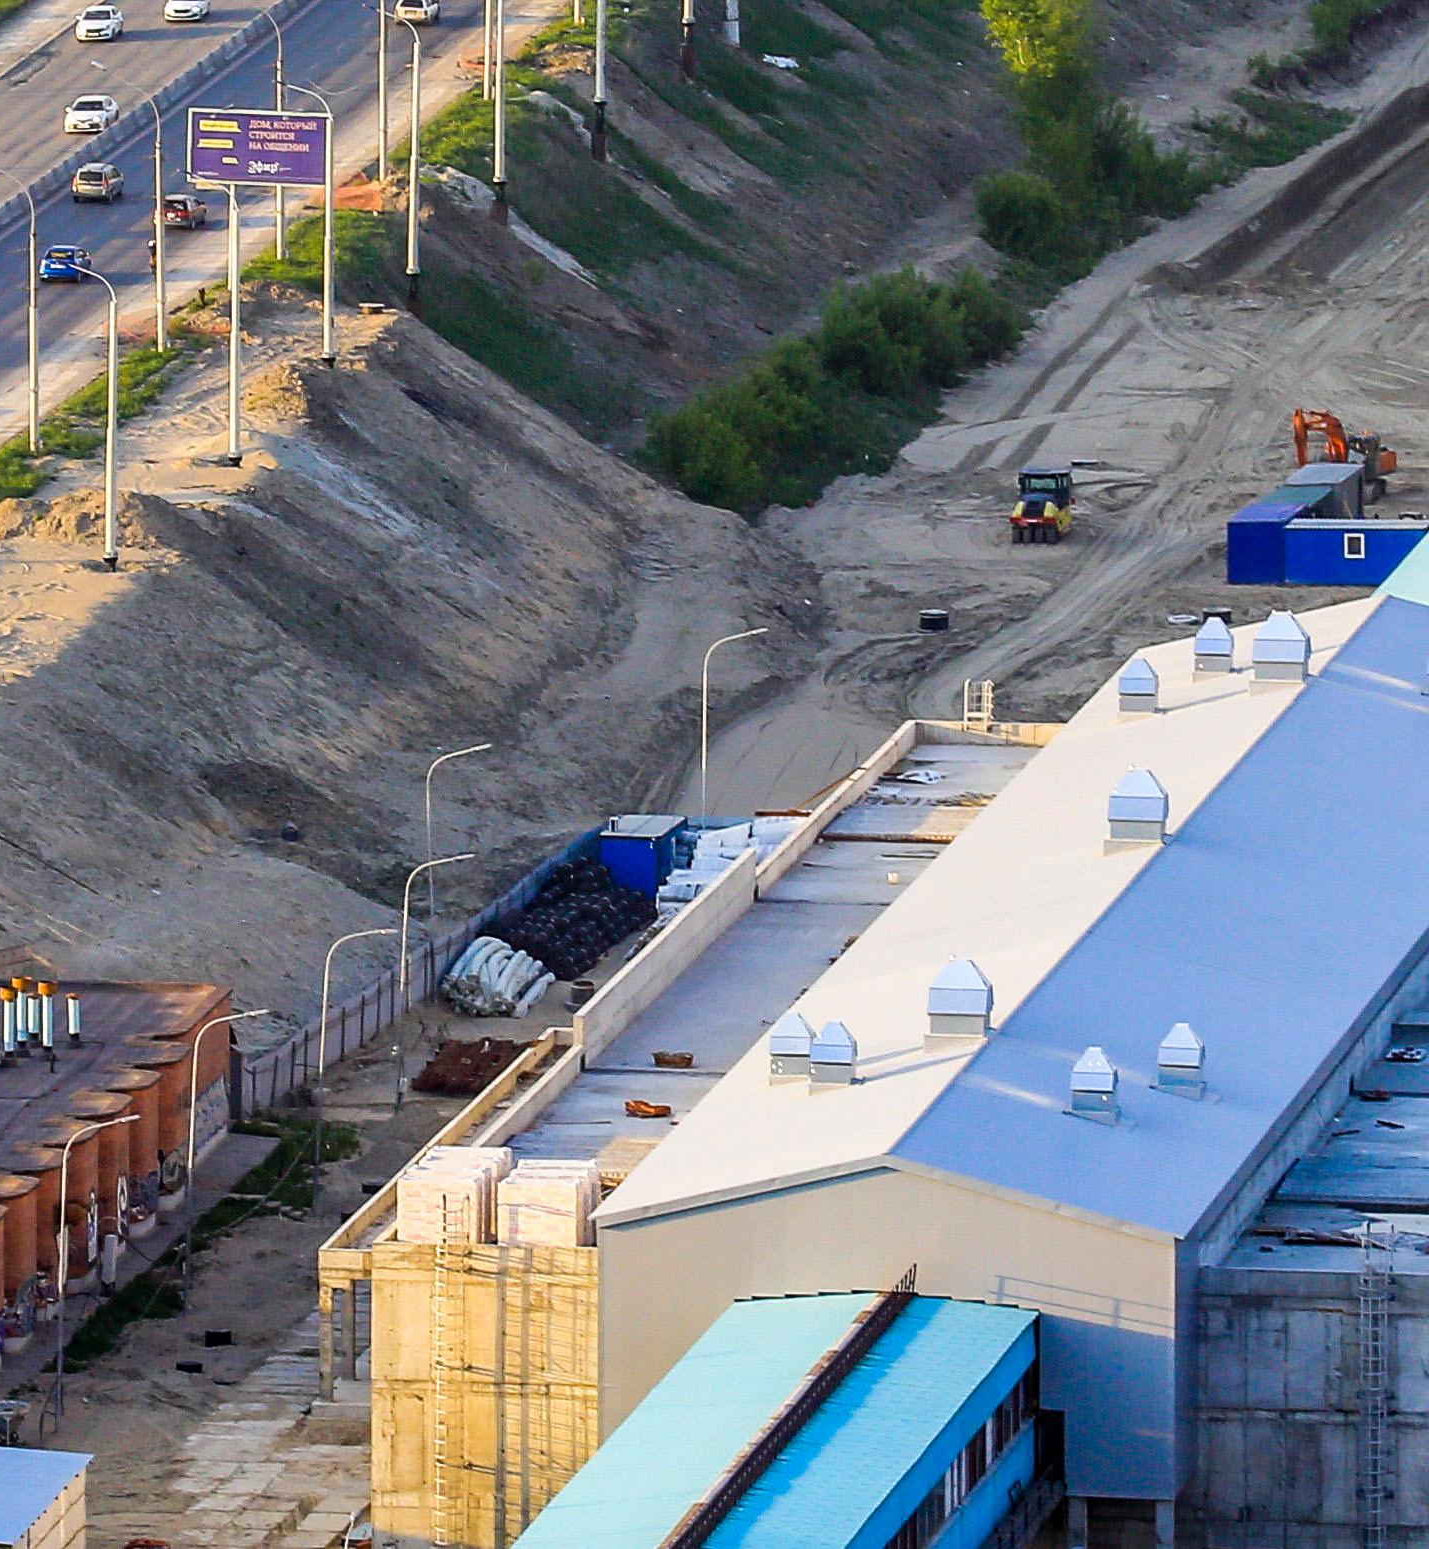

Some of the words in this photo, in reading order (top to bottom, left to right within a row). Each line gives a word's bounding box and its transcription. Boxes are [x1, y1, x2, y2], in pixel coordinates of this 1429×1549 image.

[249, 120, 272, 129] ДОМ,
[274, 121, 317, 130] КОТОРЫЙ
[249, 131, 295, 140] СТРОИТСЯ
[249, 142, 262, 150] НА
[263, 143, 310, 152] ОБЩЕНИИ
